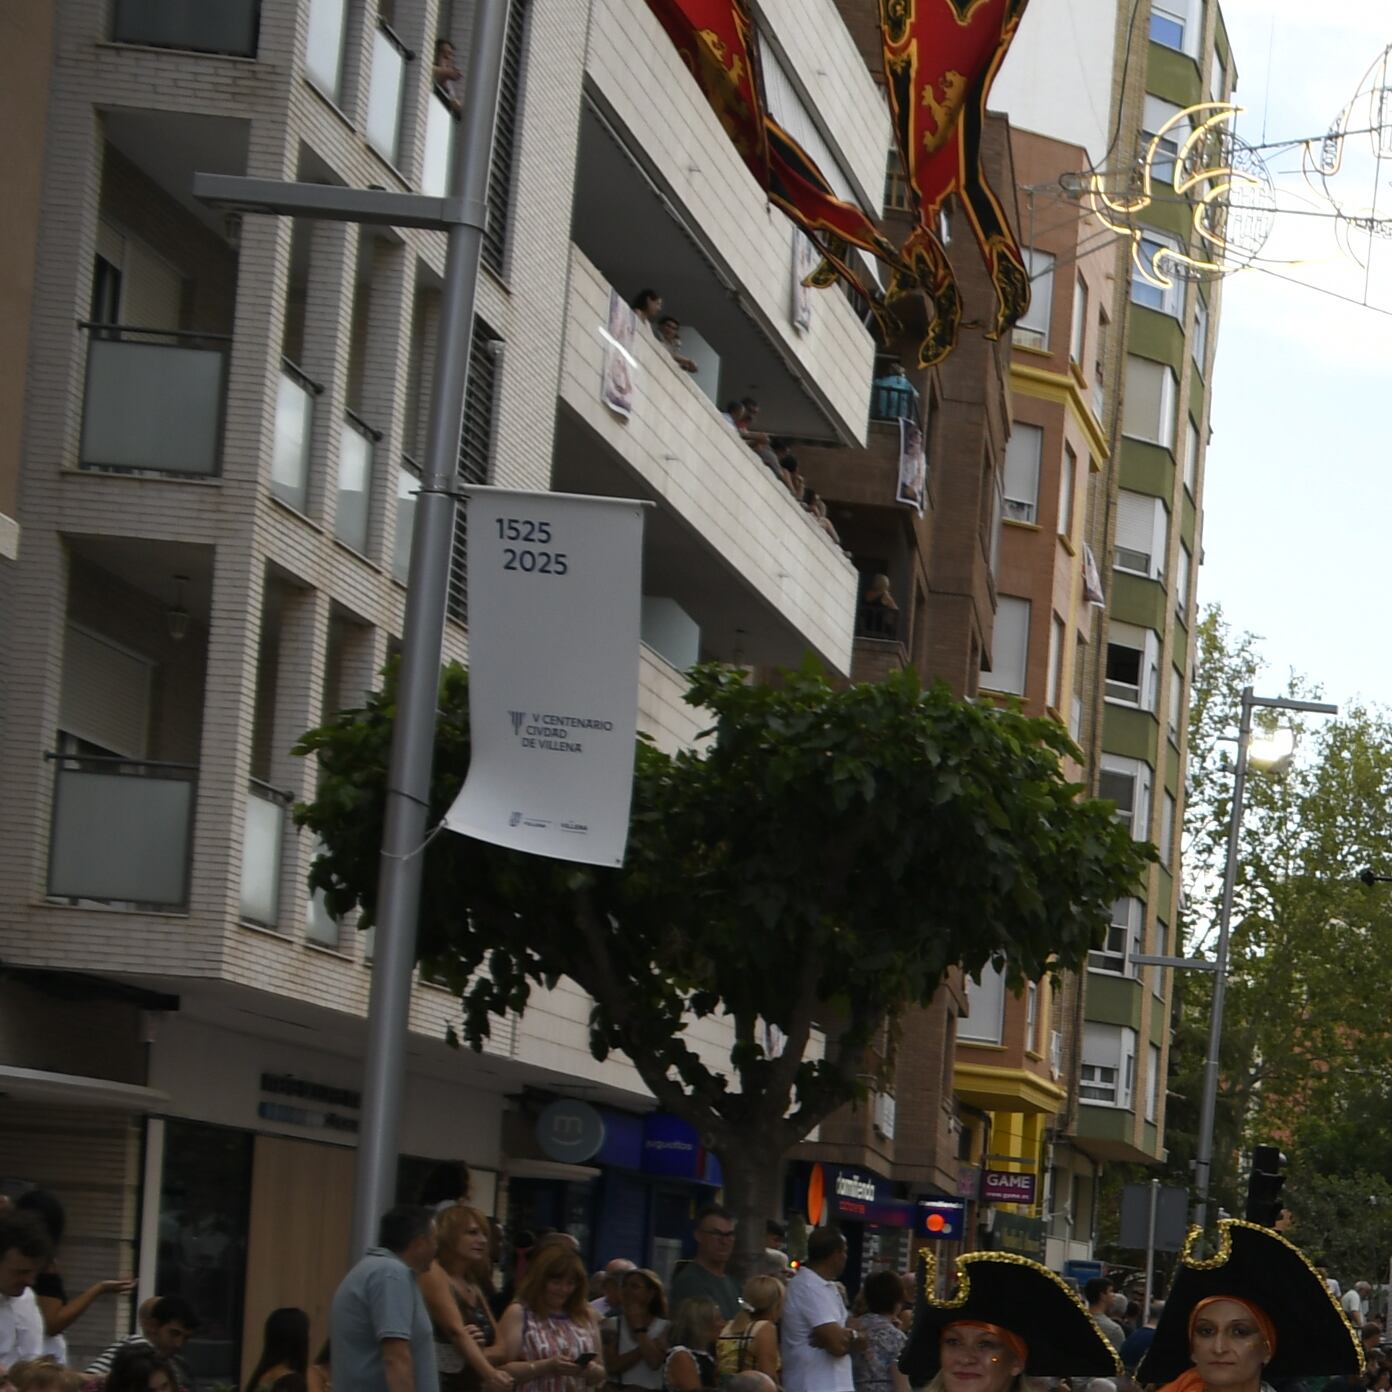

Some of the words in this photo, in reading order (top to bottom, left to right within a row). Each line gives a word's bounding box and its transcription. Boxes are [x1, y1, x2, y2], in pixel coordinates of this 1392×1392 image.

[495, 518, 552, 544] 1525
[503, 548, 568, 575] 2025
[532, 713, 540, 722] V
[542, 715, 614, 731] CENTENARIO
[526, 725, 568, 739] CIVDAD
[521, 737, 536, 748] DE
[538, 739, 582, 752] VILLENA
[986, 1174, 1031, 1189] GAME
